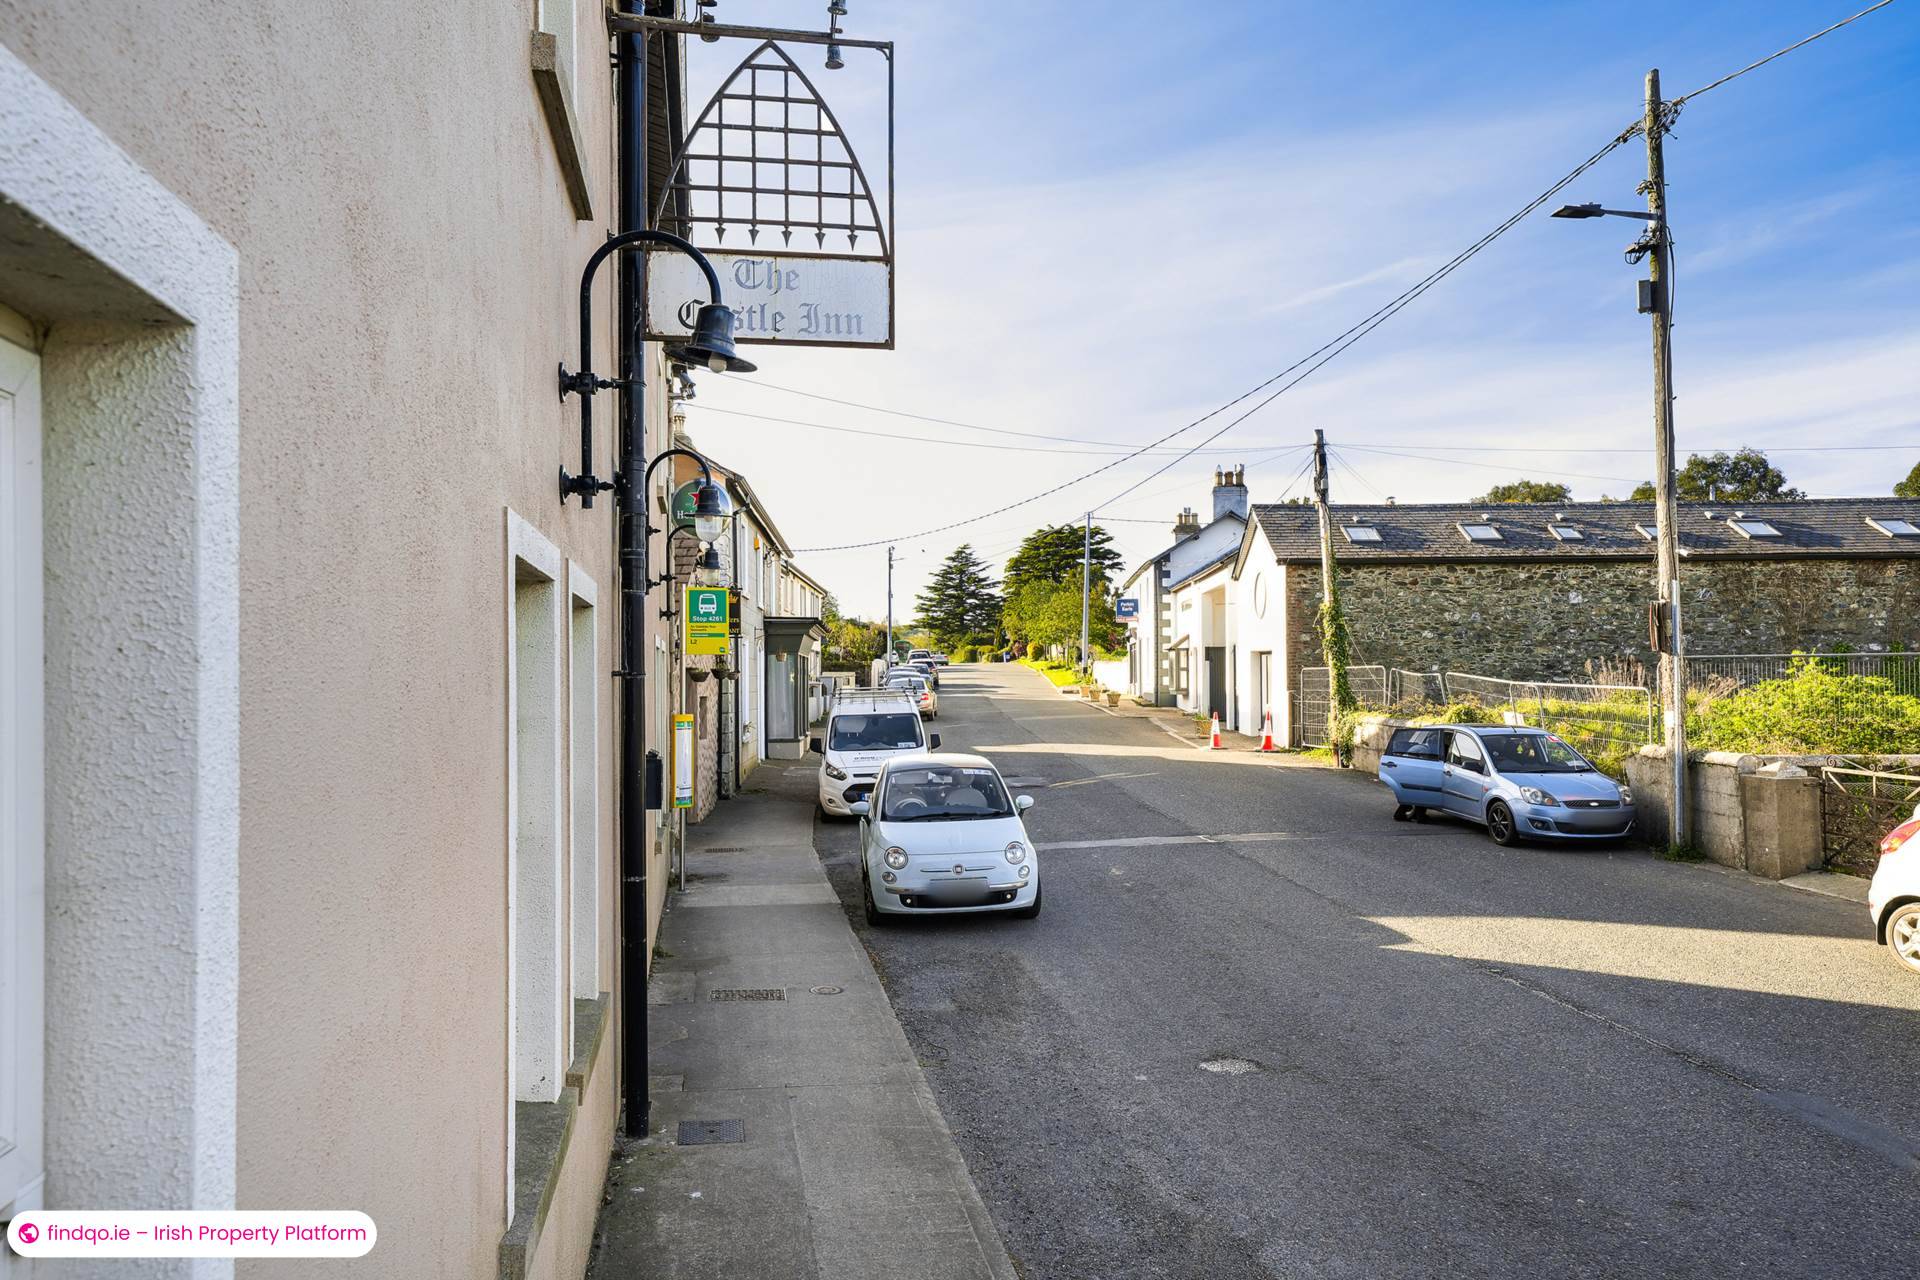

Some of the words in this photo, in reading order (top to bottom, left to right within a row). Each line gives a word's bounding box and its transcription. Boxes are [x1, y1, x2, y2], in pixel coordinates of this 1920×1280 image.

[732, 258, 800, 296] The
[677, 298, 786, 333] Cstle
[798, 302, 865, 336] Inn
